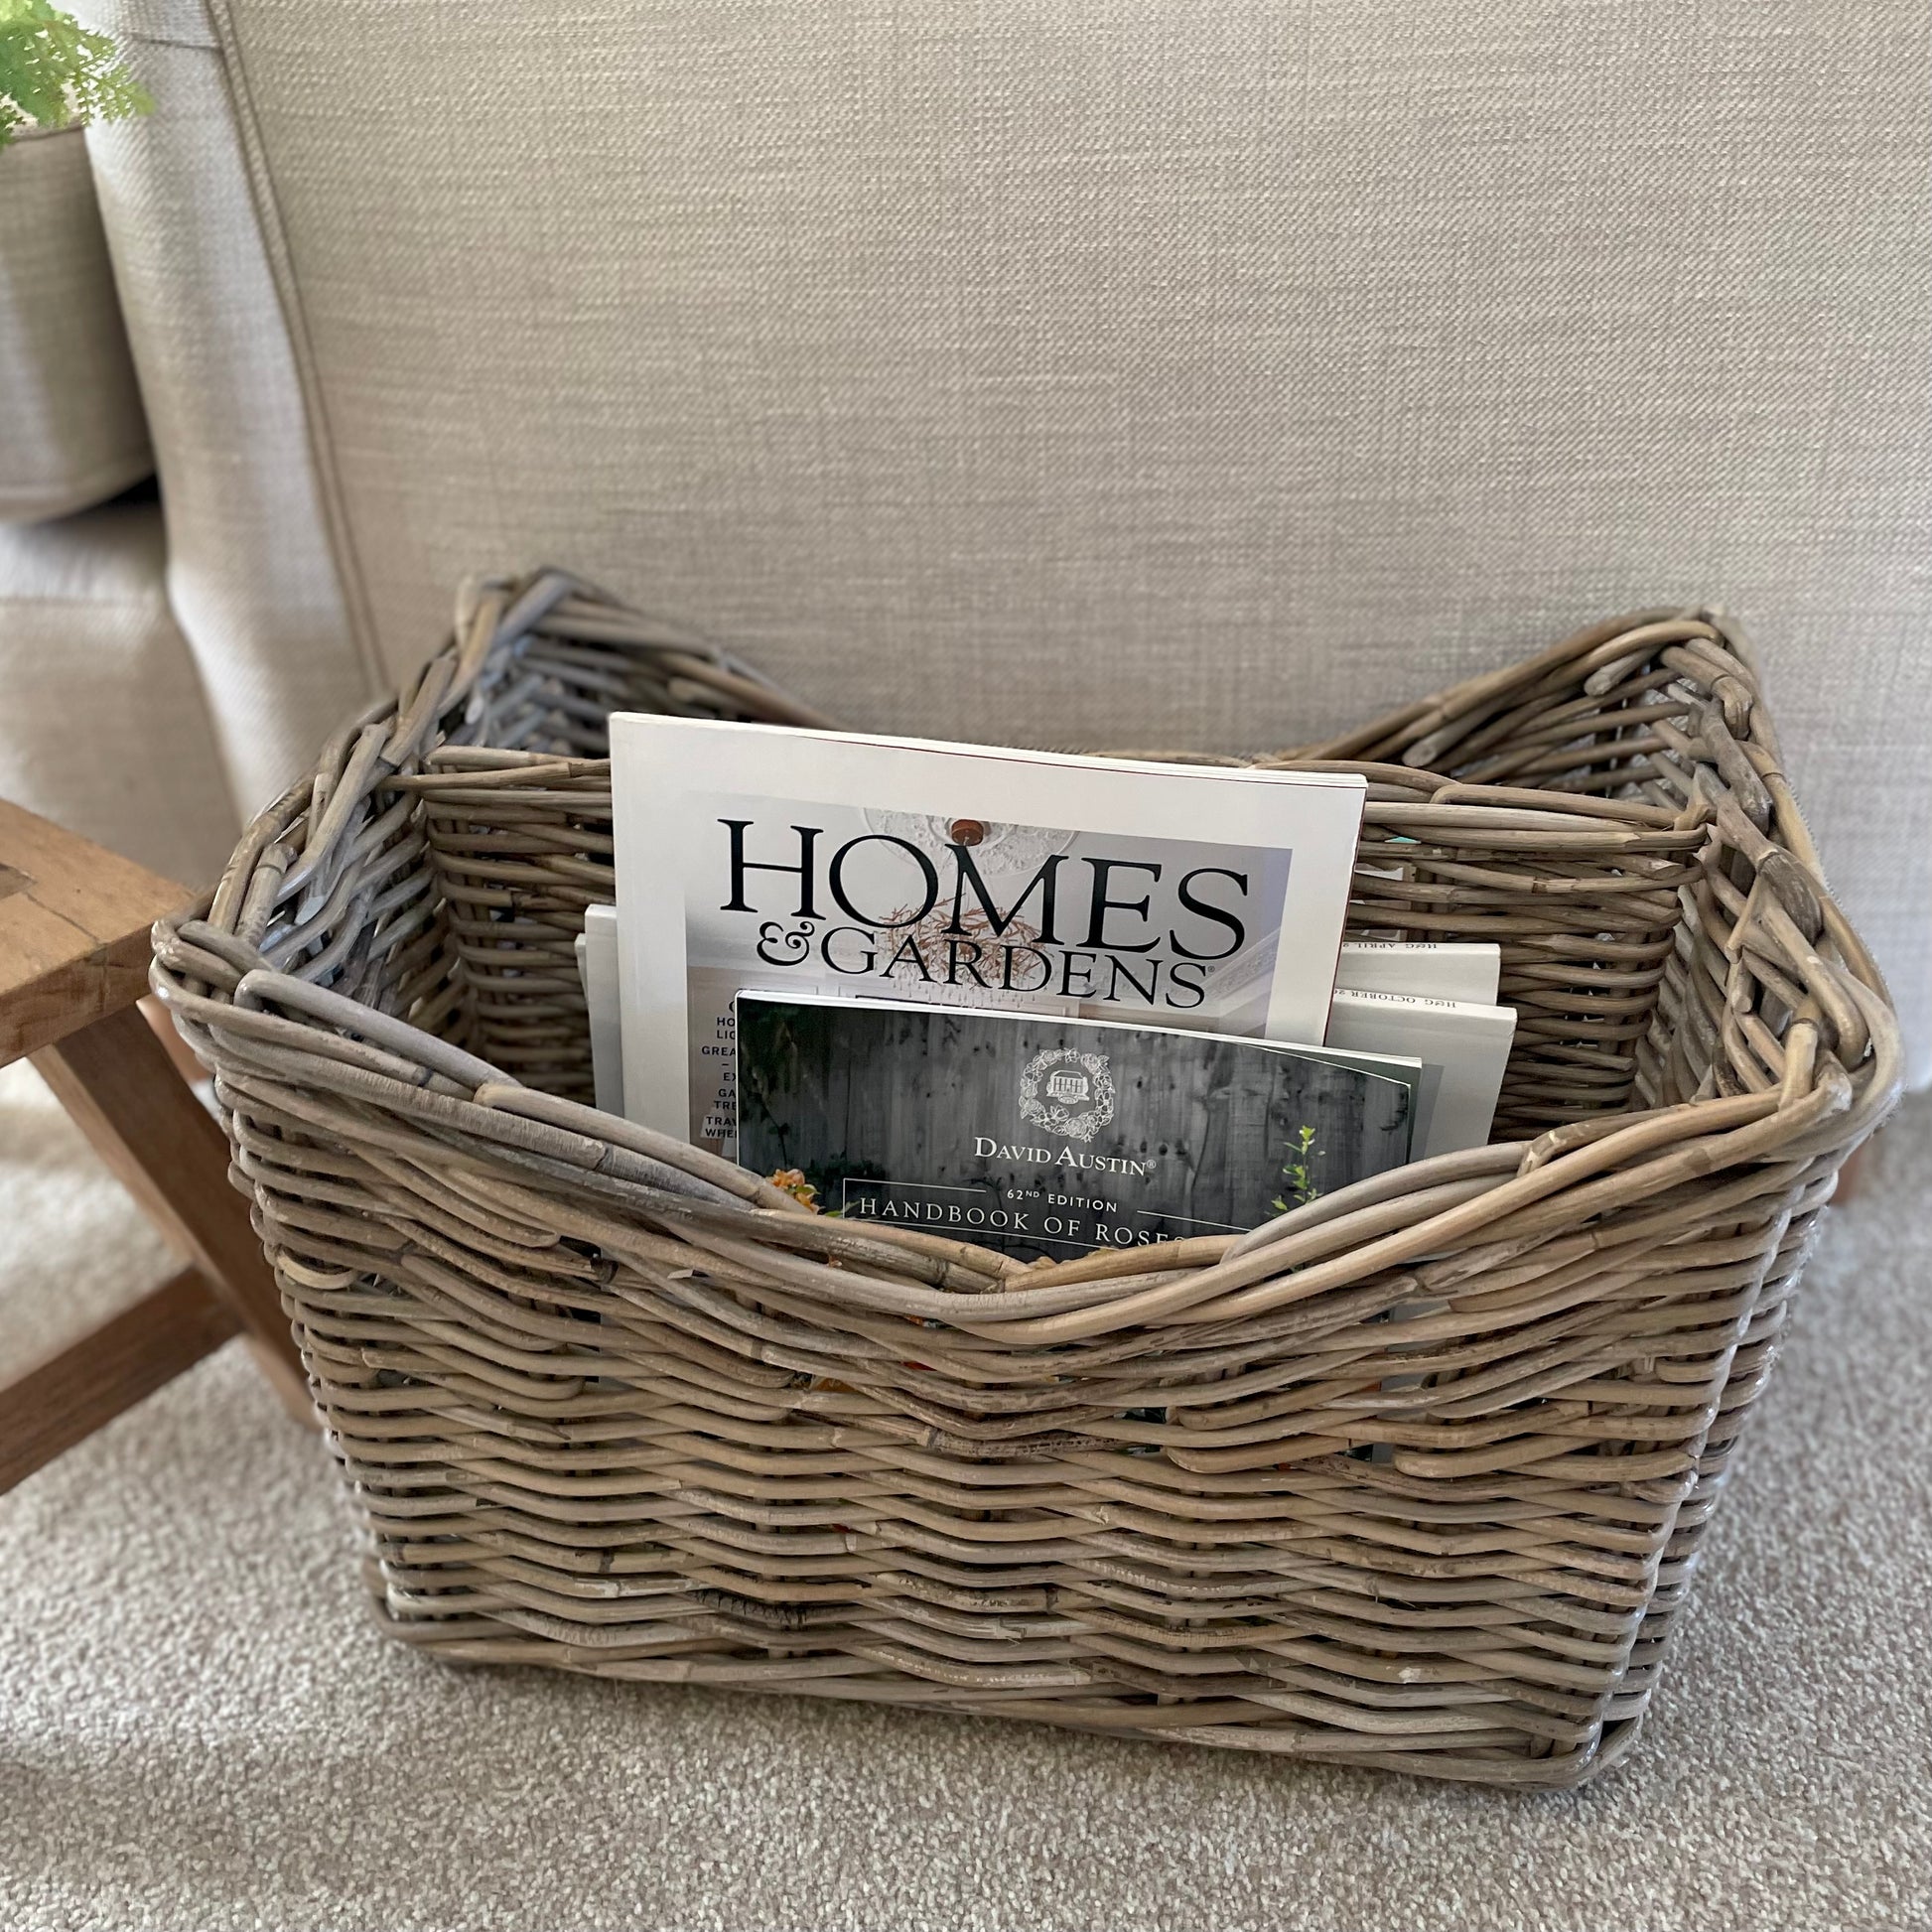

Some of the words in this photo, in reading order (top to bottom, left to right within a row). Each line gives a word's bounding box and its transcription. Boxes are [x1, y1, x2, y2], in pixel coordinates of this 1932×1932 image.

[717, 818, 1248, 961] HOMES
[1351, 990, 1416, 1004] OCTOBER
[705, 1128, 737, 1139] WHE
[974, 1137, 1051, 1164] DAVID
[1006, 1189, 1040, 1200] 62ND
[1047, 1193, 1118, 1213] EDITION
[859, 1197, 1030, 1231] HANDBOOK
[1043, 1216, 1081, 1236] OF
